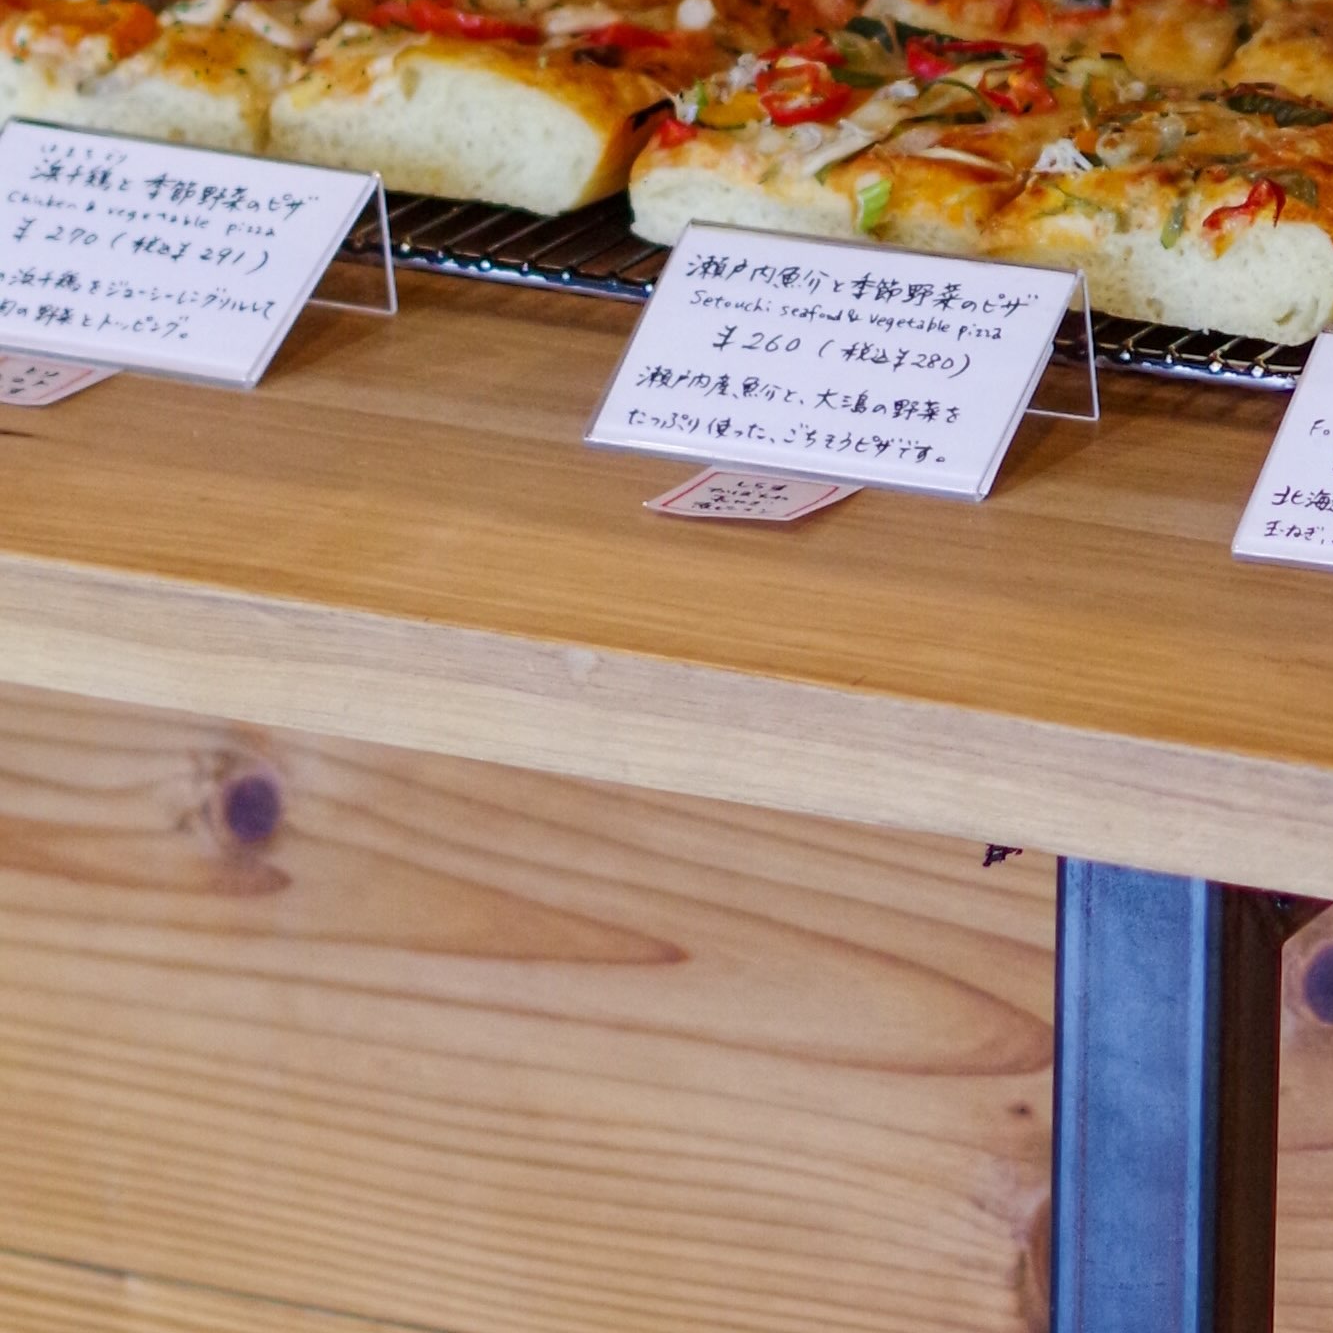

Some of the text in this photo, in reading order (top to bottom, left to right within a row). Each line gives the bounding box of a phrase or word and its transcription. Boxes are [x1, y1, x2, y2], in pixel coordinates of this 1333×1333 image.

[689, 289, 772, 314] Setouchi
[868, 314, 951, 336] vegetable
[957, 321, 1002, 341] pizza
